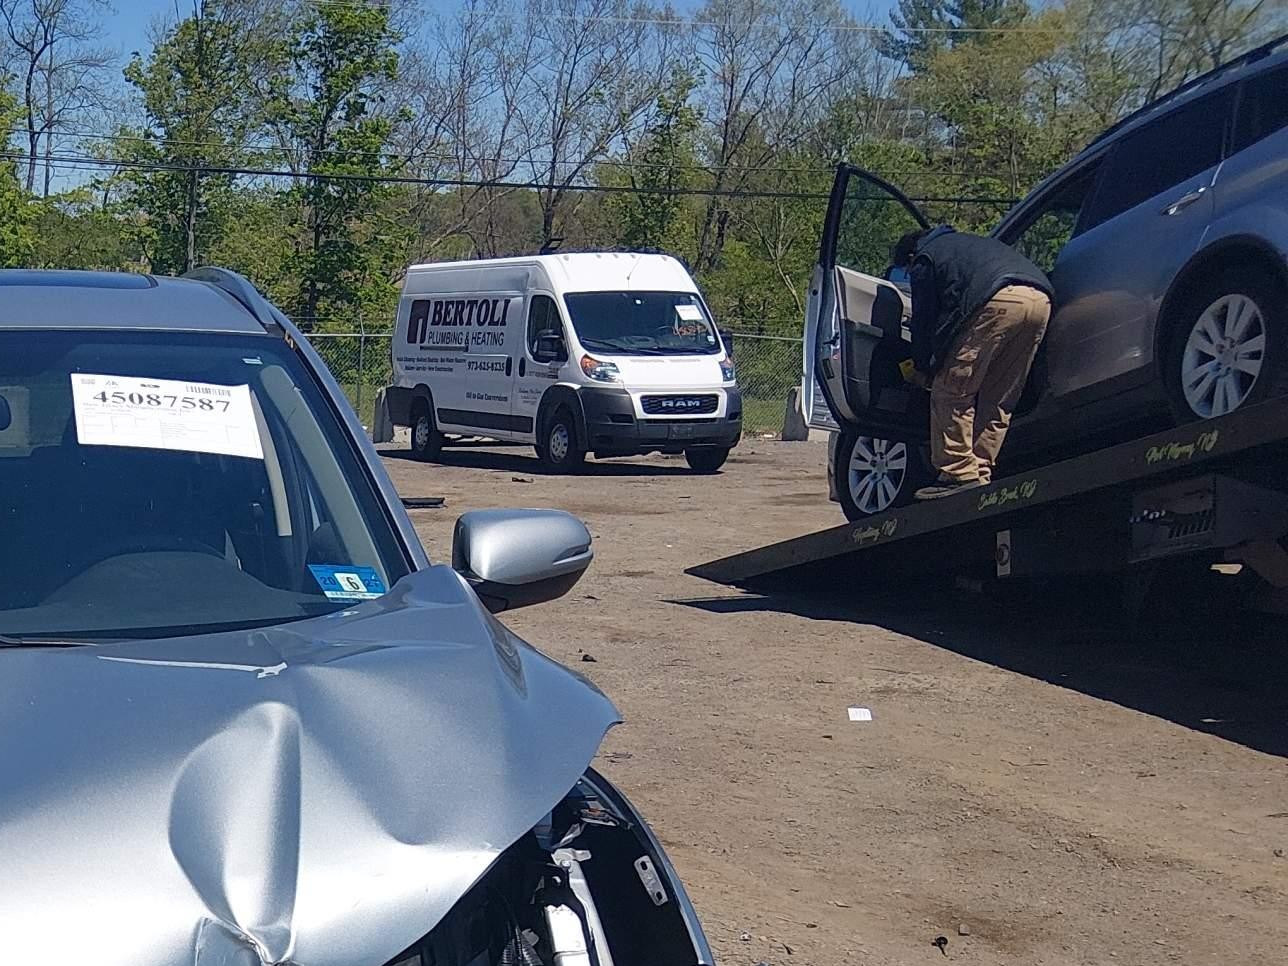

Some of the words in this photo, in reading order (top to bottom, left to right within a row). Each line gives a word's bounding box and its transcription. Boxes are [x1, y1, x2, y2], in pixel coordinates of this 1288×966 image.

[430, 298, 511, 327] BERTOLI
[428, 331, 462, 345] PLUMBING
[464, 332, 470, 346] &
[471, 332, 504, 347] HEATING
[92, 390, 231, 413] 45087587
[346, 576, 360, 590] 6
